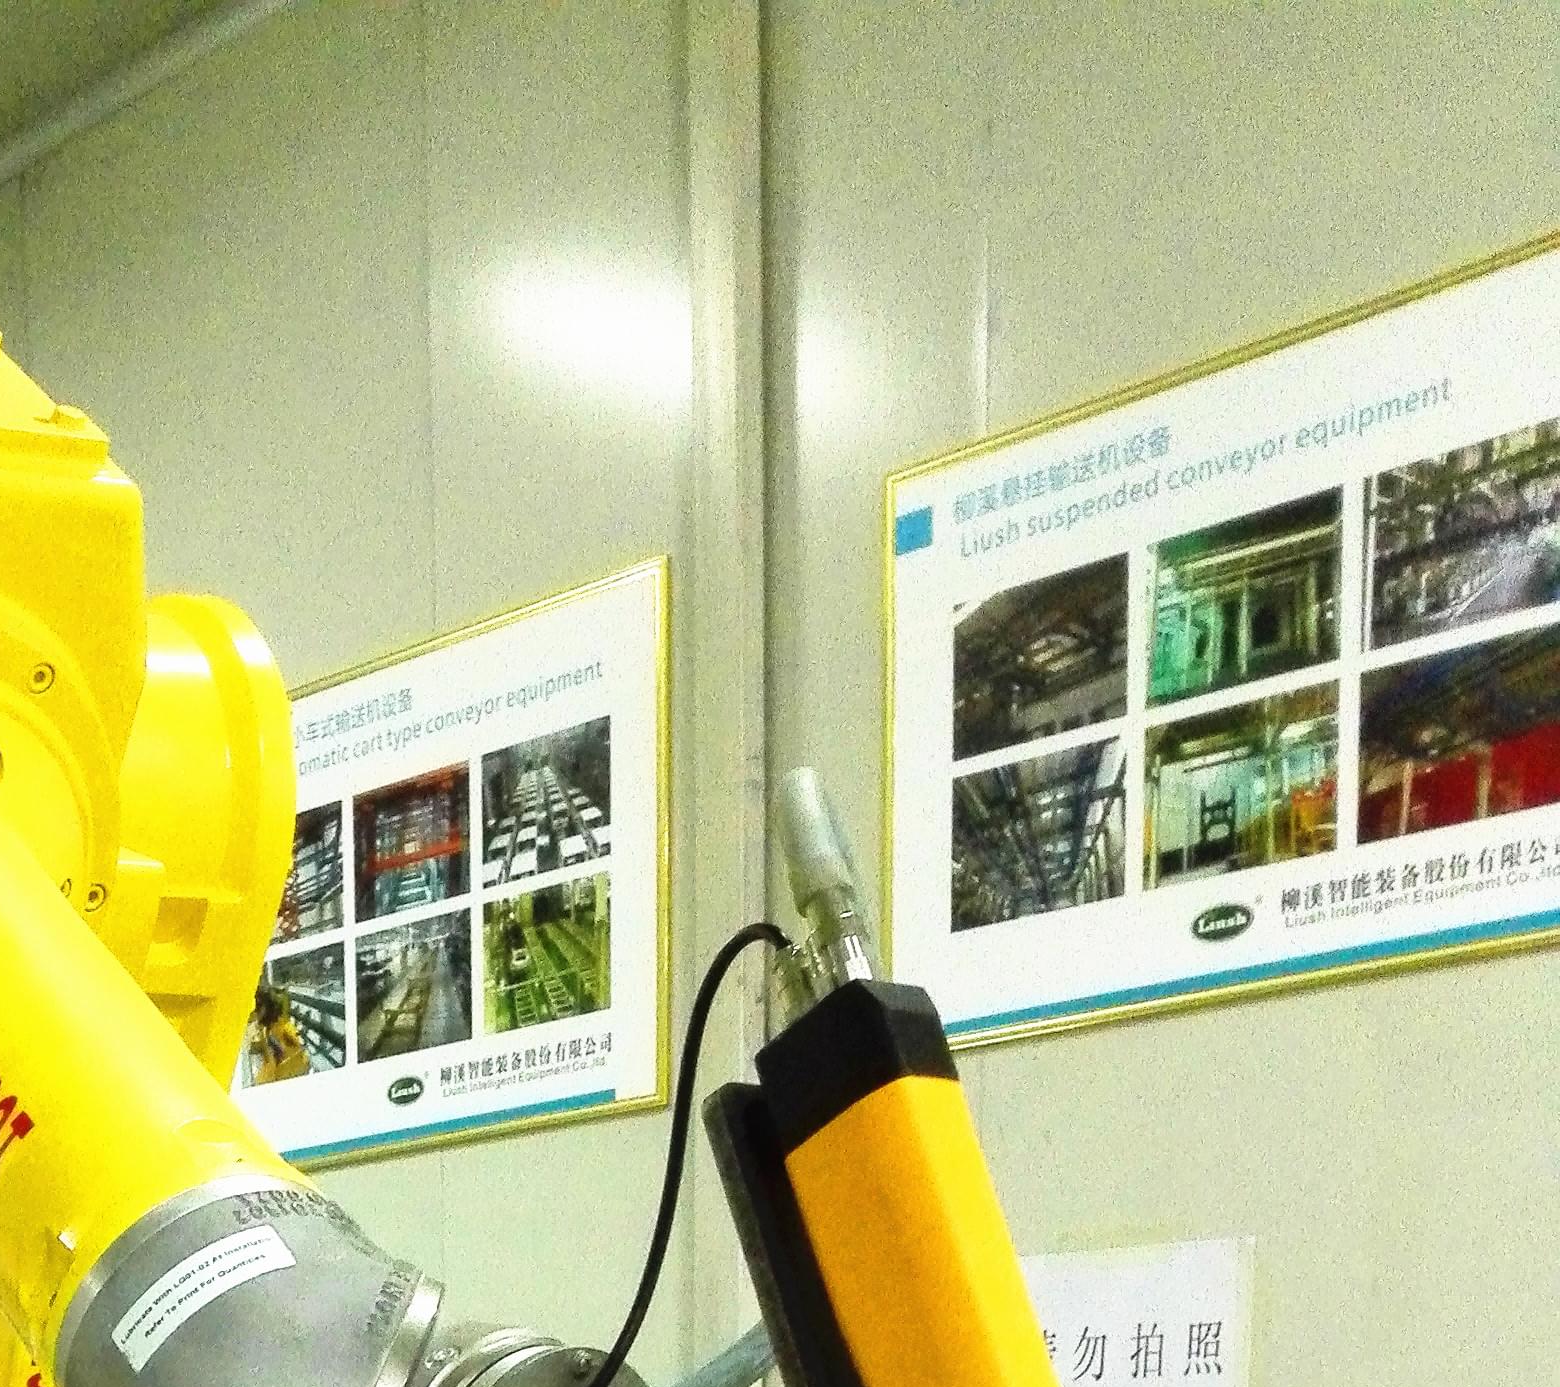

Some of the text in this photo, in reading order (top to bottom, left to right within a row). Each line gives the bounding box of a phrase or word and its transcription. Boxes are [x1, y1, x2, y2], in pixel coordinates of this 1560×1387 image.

[961, 377, 1450, 558] Liush suspended conveyor equipment
[353, 732, 383, 758] cart
[387, 720, 422, 752] type
[425, 696, 501, 731] conveyor
[506, 661, 604, 709] equipment
[1285, 909, 1326, 928] Liush
[1330, 895, 1410, 920] Intelligent
[1413, 876, 1501, 906] Equipment
[121, 1306, 153, 1345] Lubricate
[152, 1288, 173, 1306] With
[144, 1316, 165, 1338] Refer
[165, 1305, 177, 1316] To
[177, 1287, 200, 1306] Print
[200, 1276, 216, 1289] For
